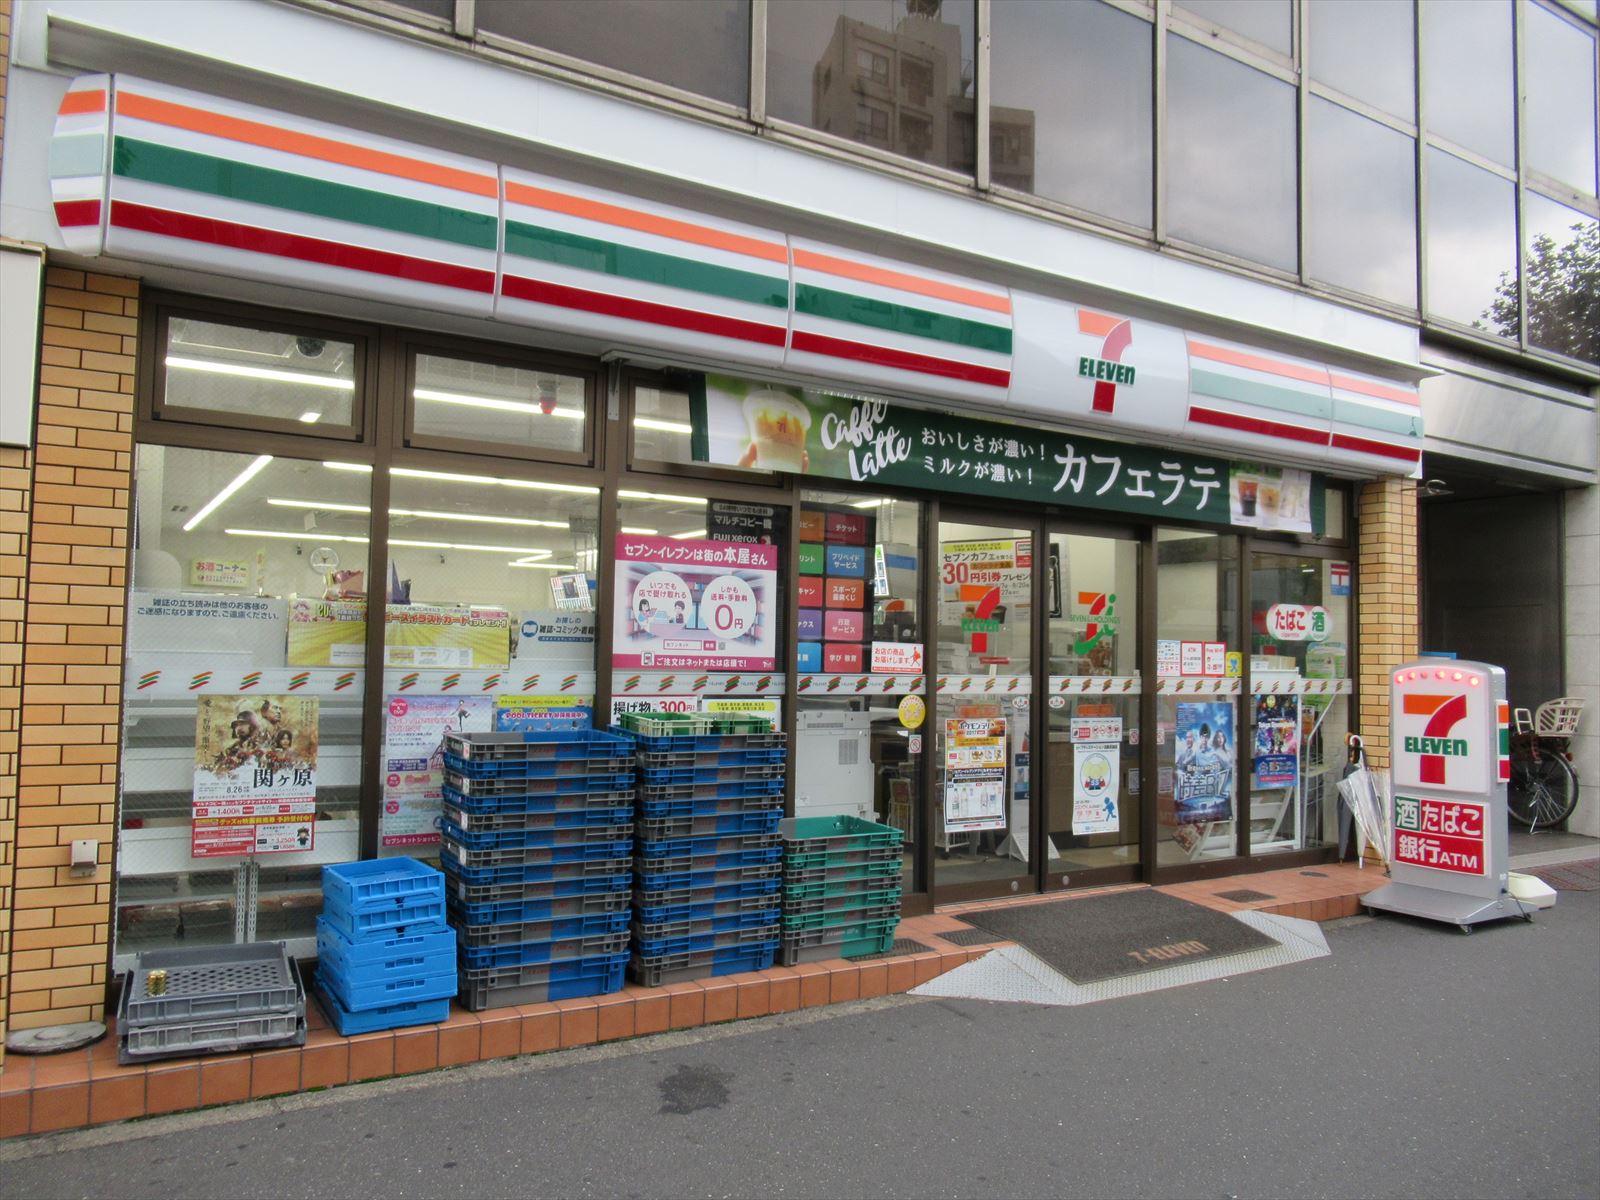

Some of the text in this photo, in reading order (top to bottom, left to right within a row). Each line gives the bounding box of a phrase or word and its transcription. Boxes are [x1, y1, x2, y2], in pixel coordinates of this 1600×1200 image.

[848, 425, 912, 482] Latte
[921, 427, 1045, 461] おいしさが濃い！
[924, 455, 1032, 485] ミルクが濃い！
[1052, 443, 1221, 511] カフェラテ
[714, 515, 773, 529] マルチコピー機
[713, 532, 758, 544] FUJI xerox
[624, 543, 768, 566] セブン・イレブンは街の本屋さん
[638, 590, 687, 599] 店で受け取れる
[649, 582, 677, 591] いつでも
[153, 598, 269, 610] 雑誌の立ち読みは他のお客様の
[1275, 608, 1326, 632] たばこ 酒
[1403, 694, 1467, 785] 7
[253, 768, 313, 789] 関ヶ原
[1395, 798, 1481, 836] 酒 たばこ
[1399, 835, 1478, 869] 銀行ATM
